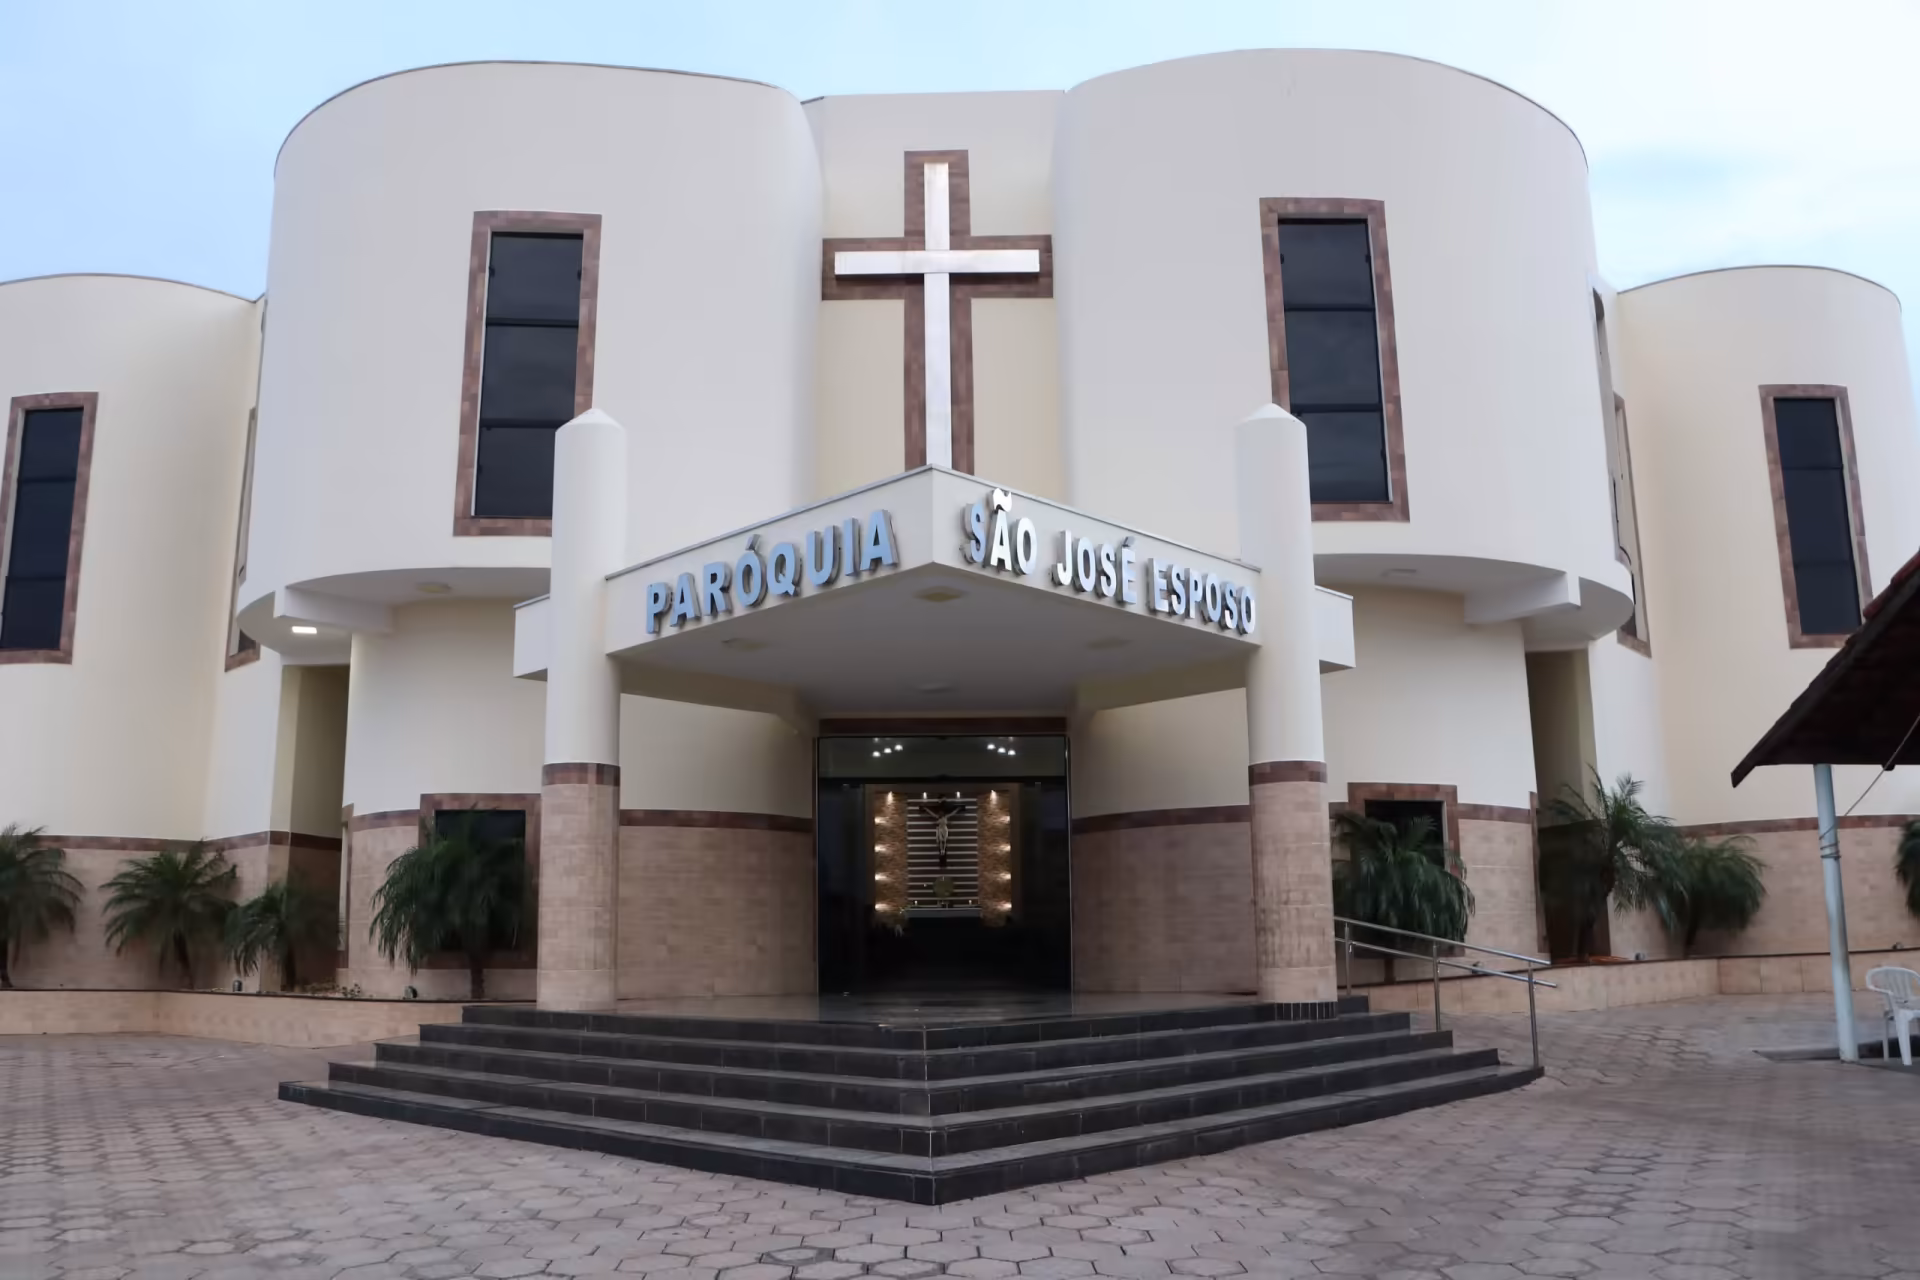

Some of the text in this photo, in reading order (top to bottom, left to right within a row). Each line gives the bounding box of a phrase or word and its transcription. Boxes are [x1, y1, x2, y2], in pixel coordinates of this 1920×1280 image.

[646, 509, 898, 634] PARÓQUIA
[963, 488, 1256, 634] SÃO JOSÉ ESPOSO
